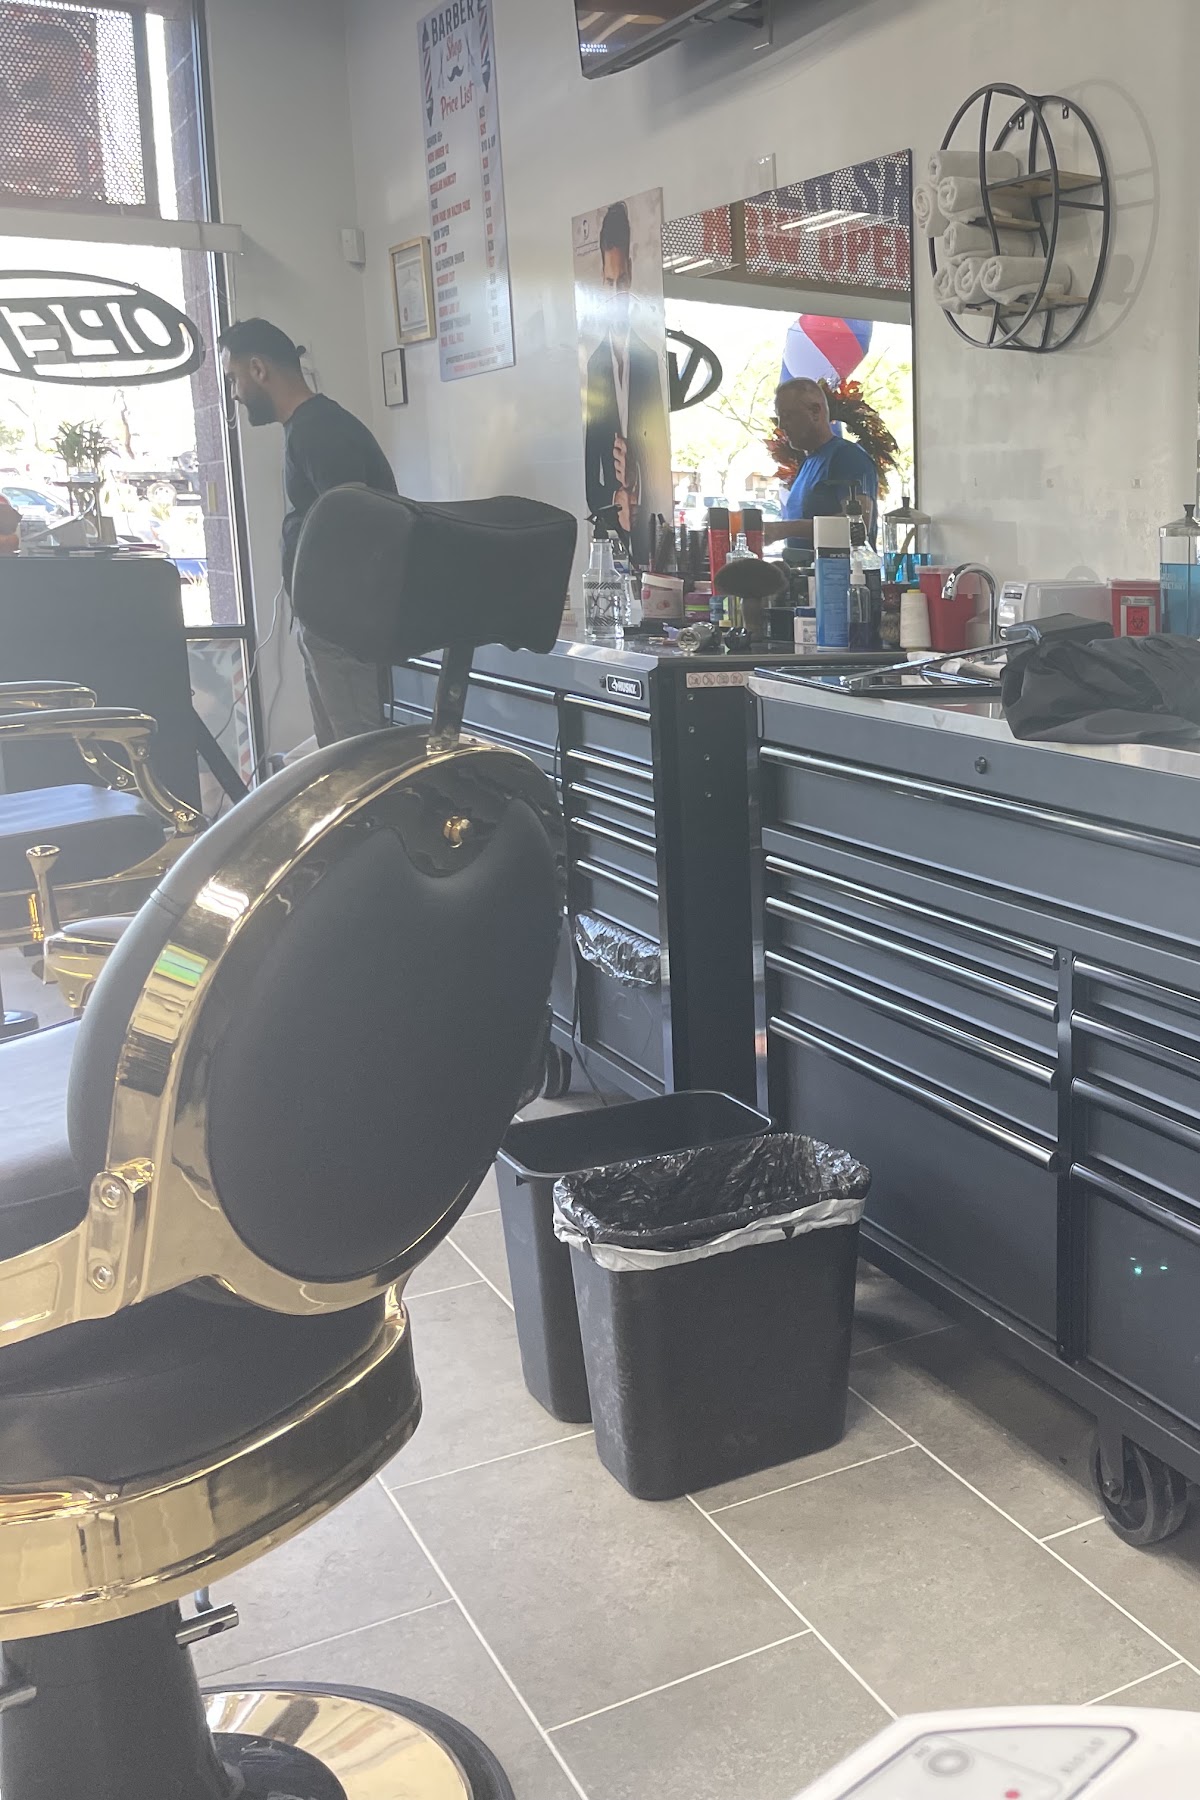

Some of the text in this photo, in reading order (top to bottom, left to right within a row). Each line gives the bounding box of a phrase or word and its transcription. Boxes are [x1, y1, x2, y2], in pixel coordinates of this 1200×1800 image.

[431, 0, 475, 48] BARBER
[446, 33, 462, 62] Shop
[440, 80, 475, 120] Price List
